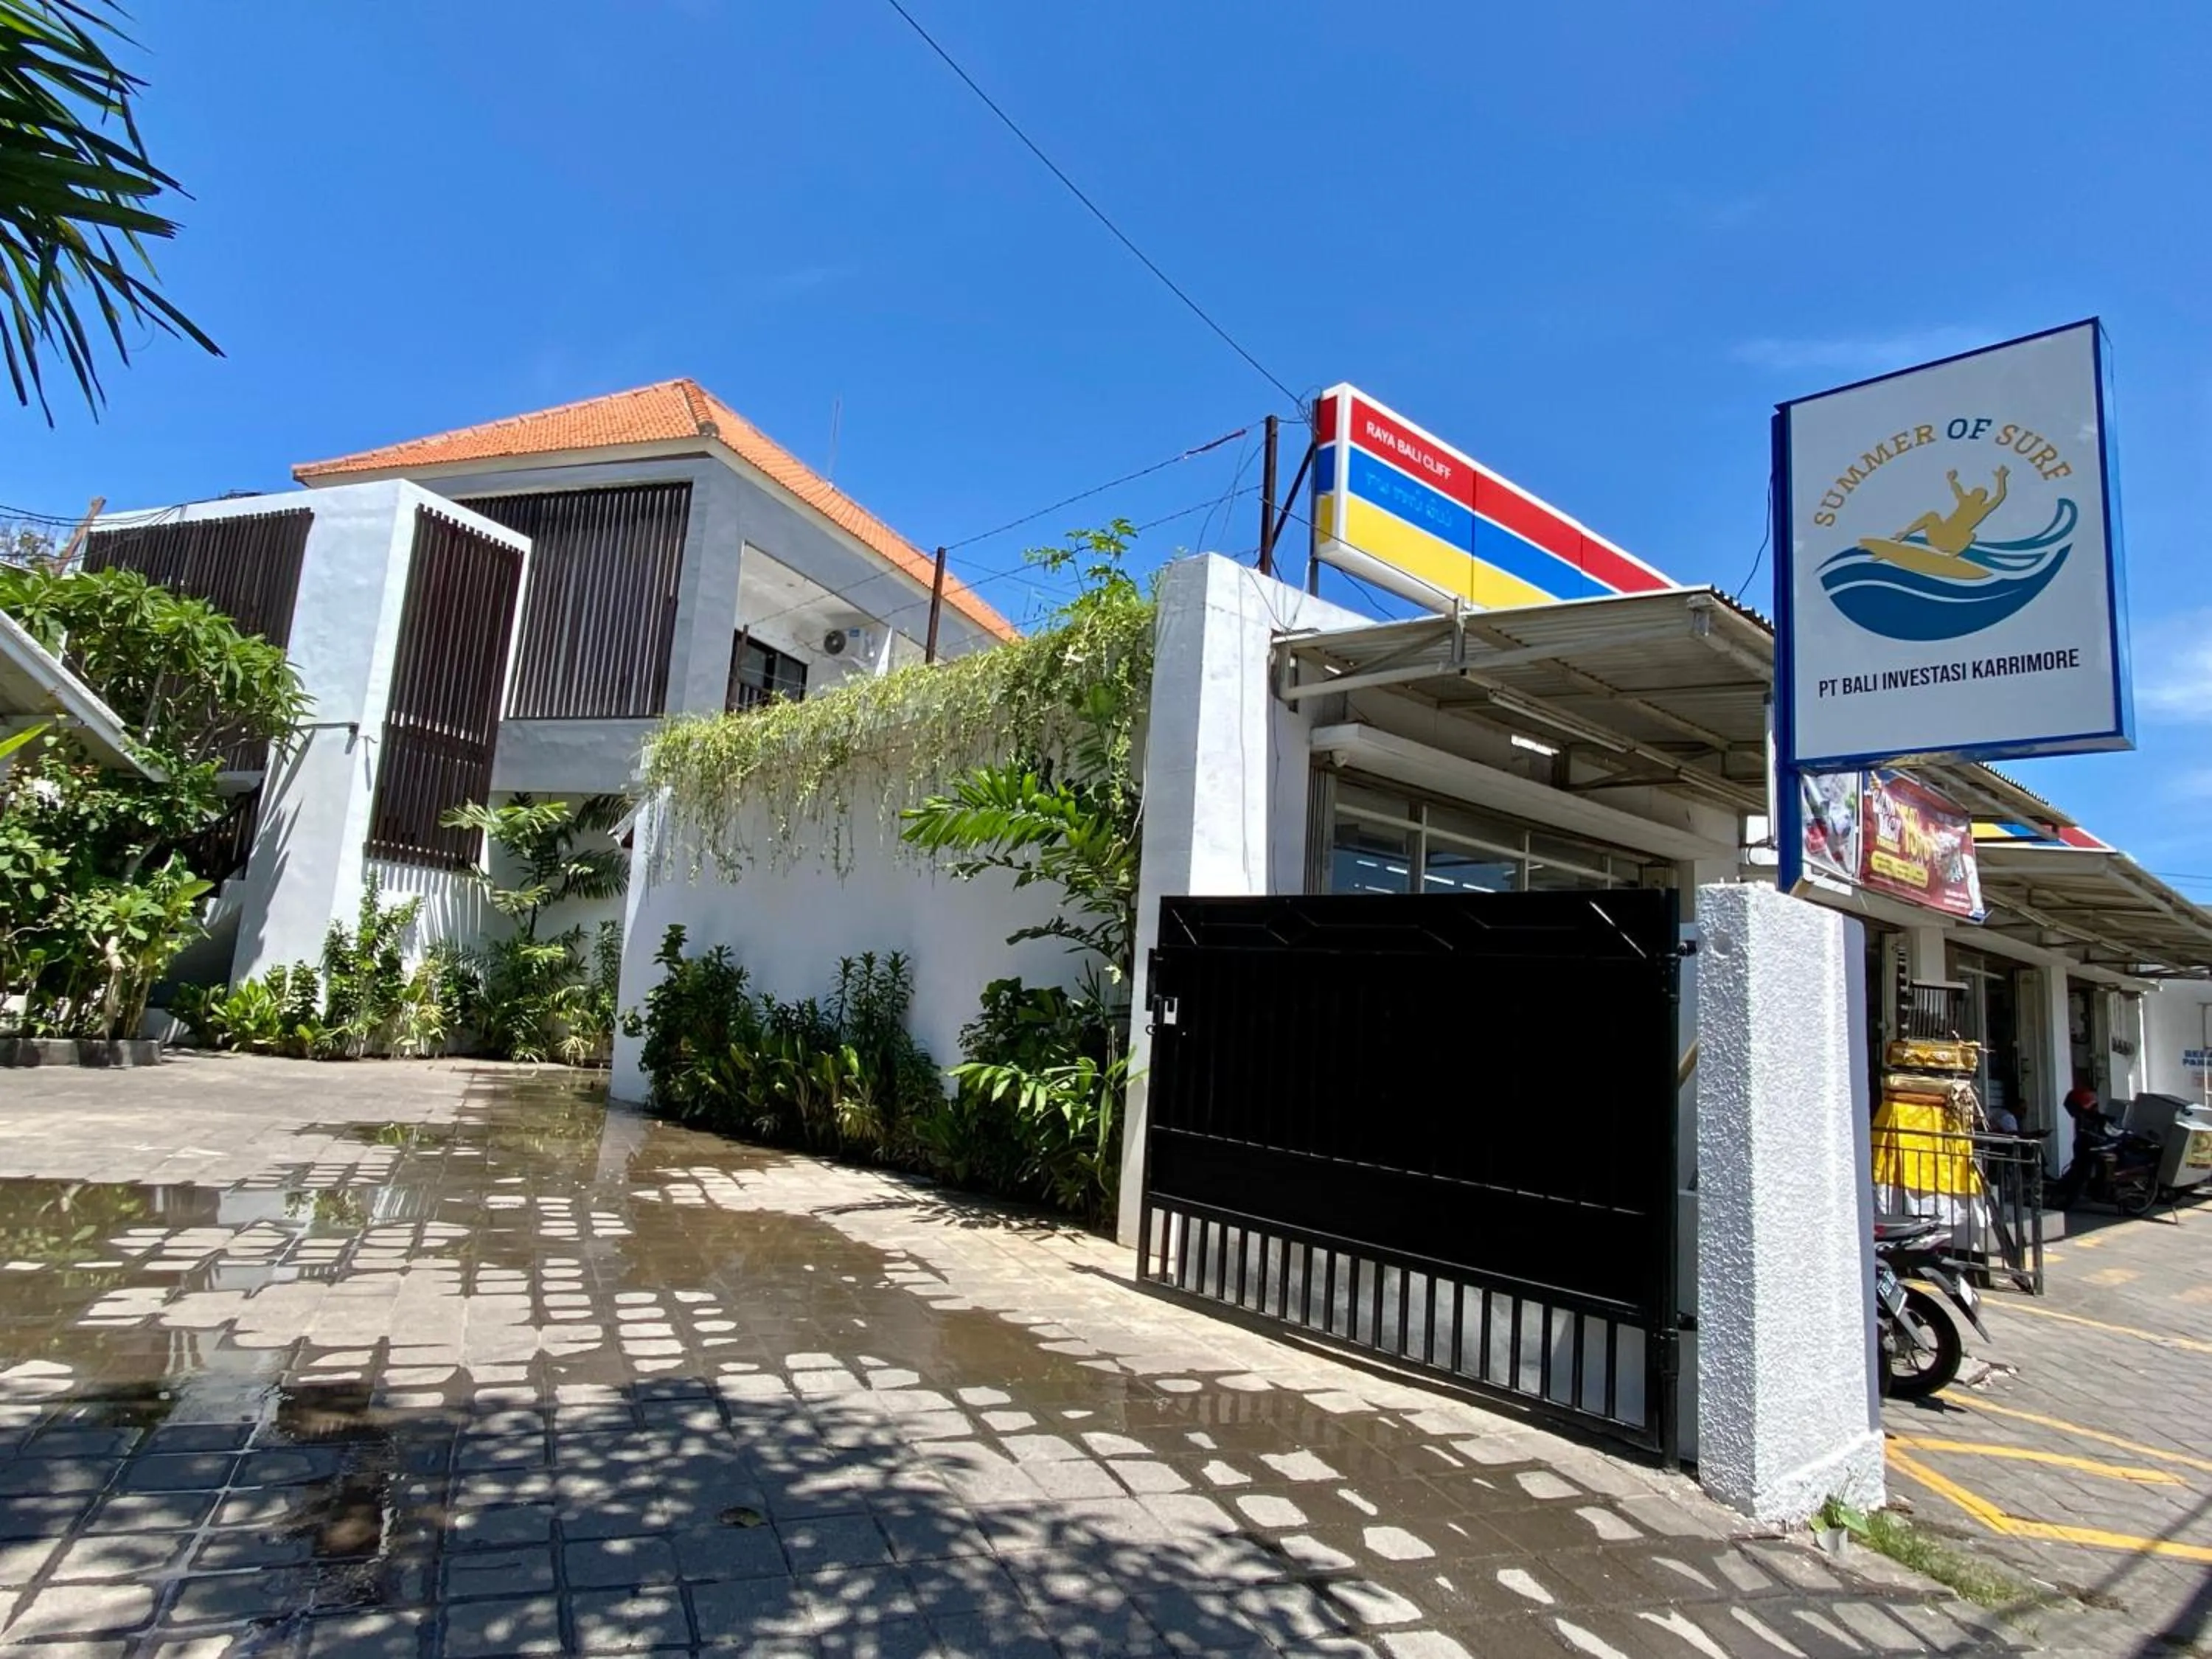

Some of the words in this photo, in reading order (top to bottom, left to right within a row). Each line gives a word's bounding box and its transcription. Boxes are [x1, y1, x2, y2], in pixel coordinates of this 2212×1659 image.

[1366, 420, 1396, 449] RAYA
[1397, 439, 1422, 464] BALI
[1422, 454, 1452, 480] CLIFF
[1815, 425, 1936, 527] SUMMER
[1947, 418, 1992, 439] OF
[1995, 424, 2072, 481] SURF
[1819, 679, 1839, 698] PT
[1843, 677, 1878, 695] BALI
[1882, 663, 1966, 690] INVESTASI
[1972, 648, 2080, 680] KARRIMORE
